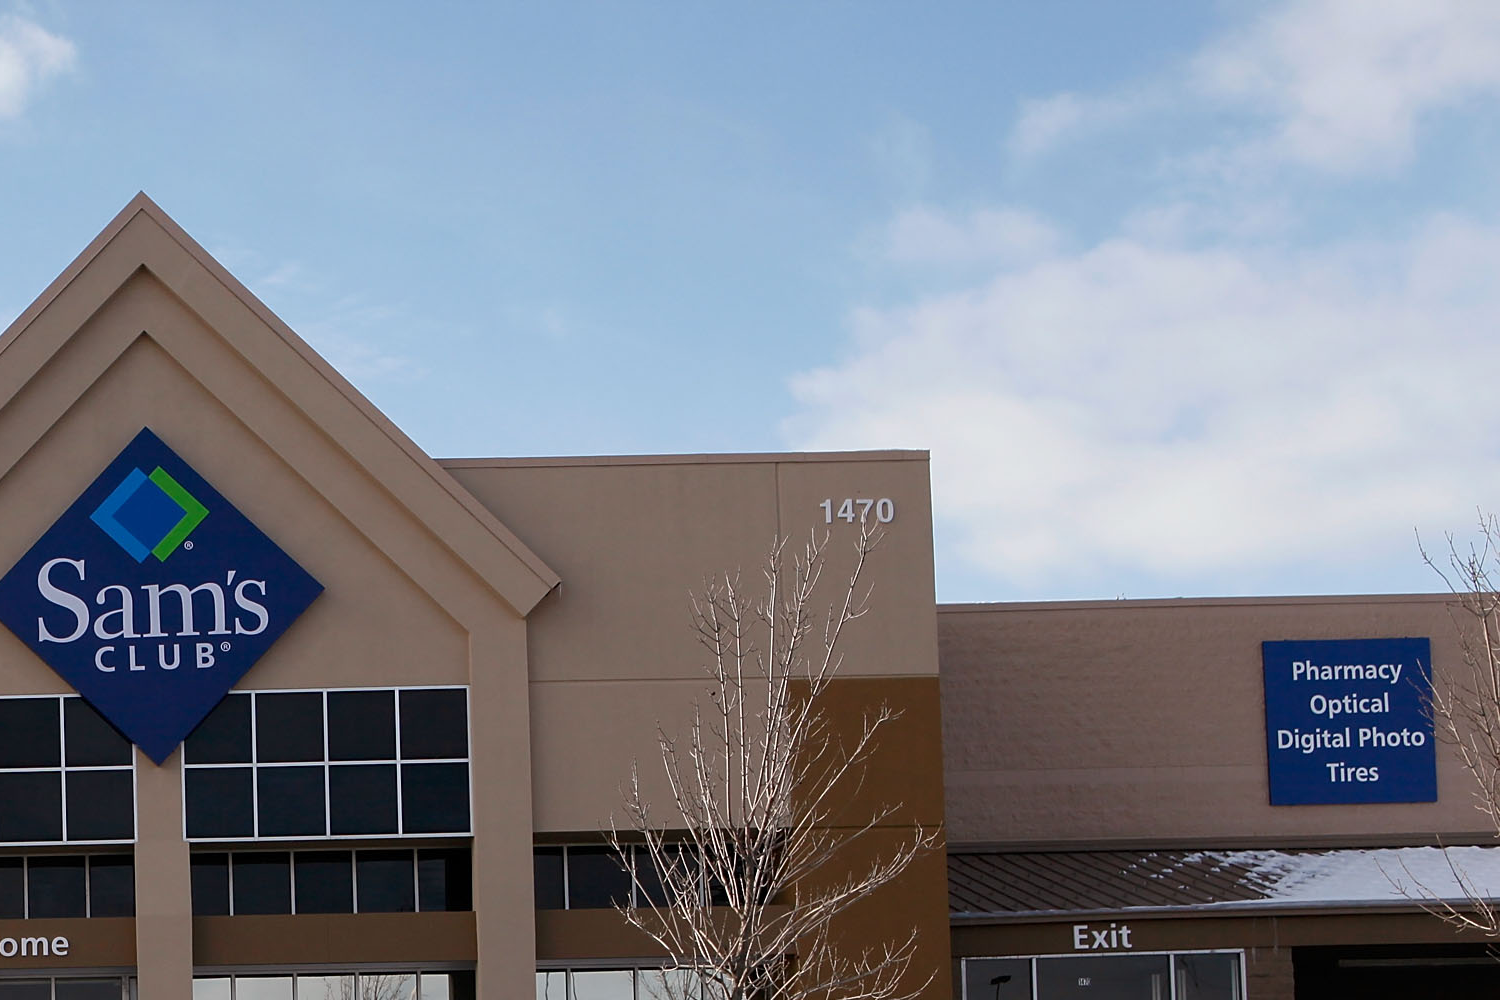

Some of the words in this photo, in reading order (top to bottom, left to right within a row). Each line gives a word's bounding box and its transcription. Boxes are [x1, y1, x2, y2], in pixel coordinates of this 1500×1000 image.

[820, 498, 894, 523] 1470
[37, 558, 269, 643] Sam's
[1292, 660, 1402, 684] Pharmacy
[1310, 692, 1390, 719] Optical
[1277, 727, 1350, 754] Digital
[1358, 727, 1426, 748] Photo
[1326, 762, 1379, 782] Tires
[1073, 923, 1132, 949] Exit
